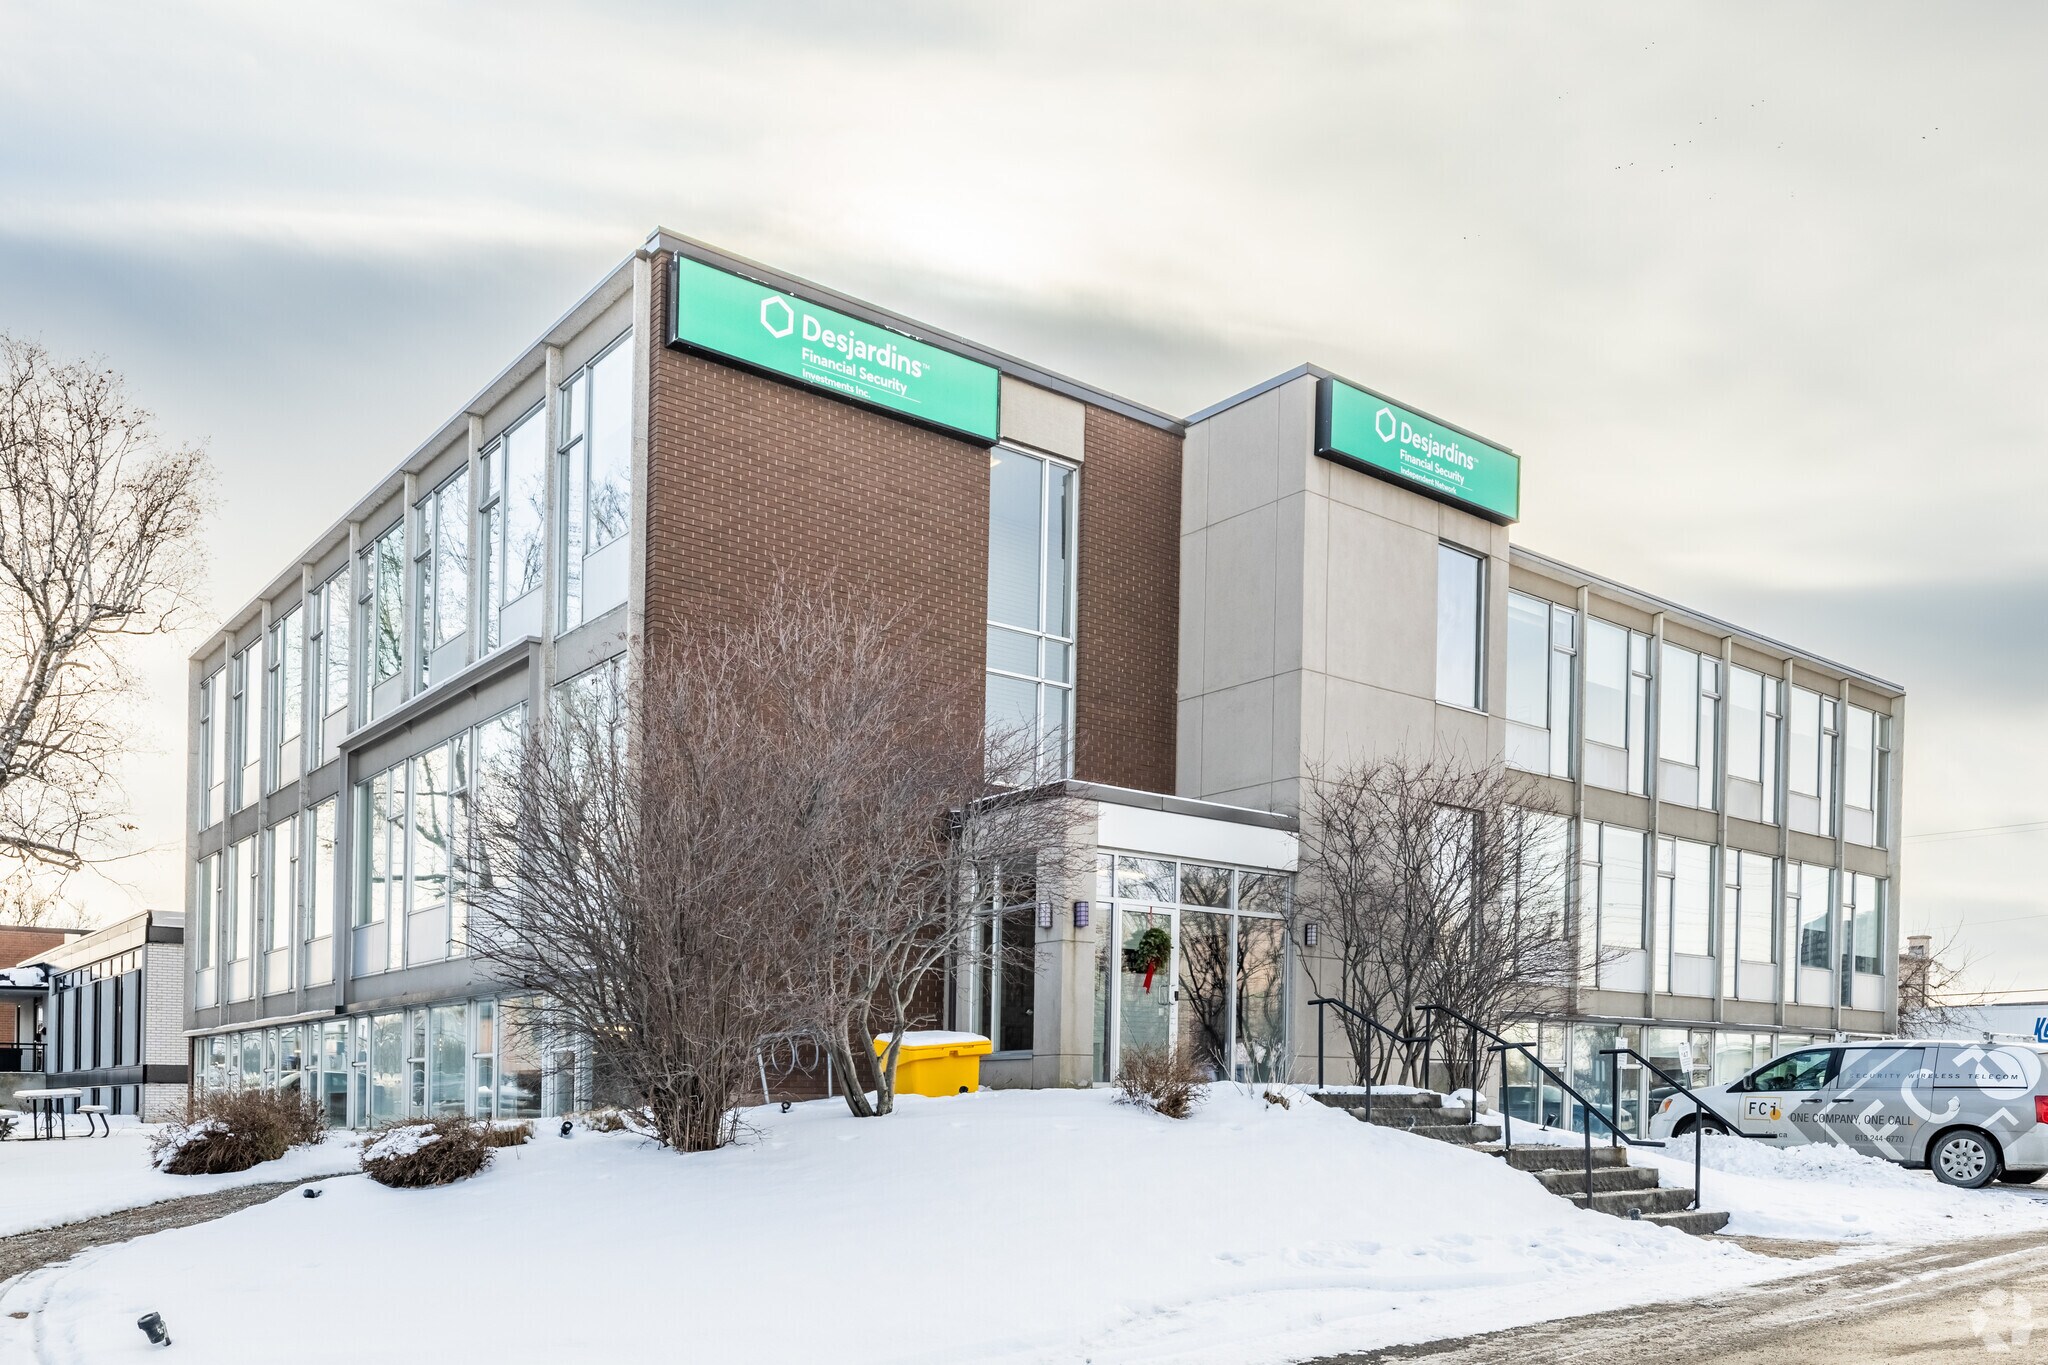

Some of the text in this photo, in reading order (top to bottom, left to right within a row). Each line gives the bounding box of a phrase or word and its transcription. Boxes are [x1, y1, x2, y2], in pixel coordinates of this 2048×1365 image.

[802, 314, 922, 378] Desjardins
[801, 347, 907, 396] Financial Security
[802, 368, 871, 399] Investments Inc.
[1400, 421, 1474, 470] Desjardins
[1400, 449, 1464, 486] Financial Security
[1400, 466, 1457, 494] Independent Network
[1907, 1072, 1961, 1080] WIRELESS
[1790, 1112, 1914, 1126] ONE COMPANY, ONE CALL
[1854, 1134, 1905, 1143] 613 244-6770
